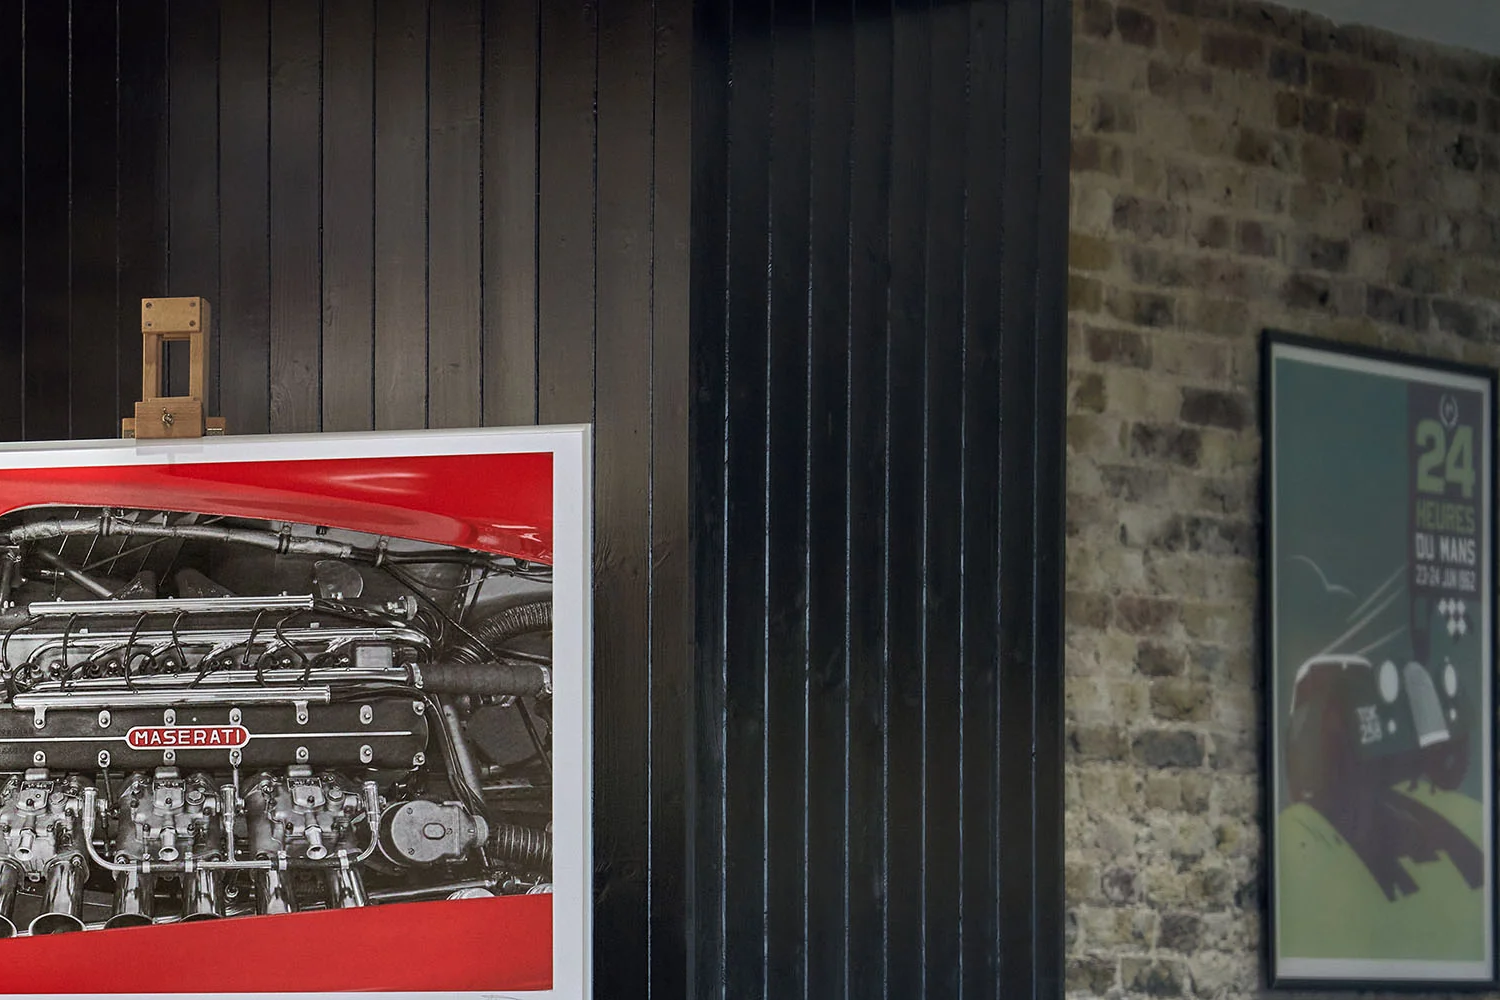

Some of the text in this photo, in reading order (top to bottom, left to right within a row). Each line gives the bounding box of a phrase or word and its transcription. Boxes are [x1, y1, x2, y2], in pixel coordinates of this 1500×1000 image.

[1416, 418, 1476, 499] 24
[1416, 500, 1476, 535] HEURES
[1416, 532, 1476, 566] DU MANS
[134, 729, 240, 745] MASERATI
